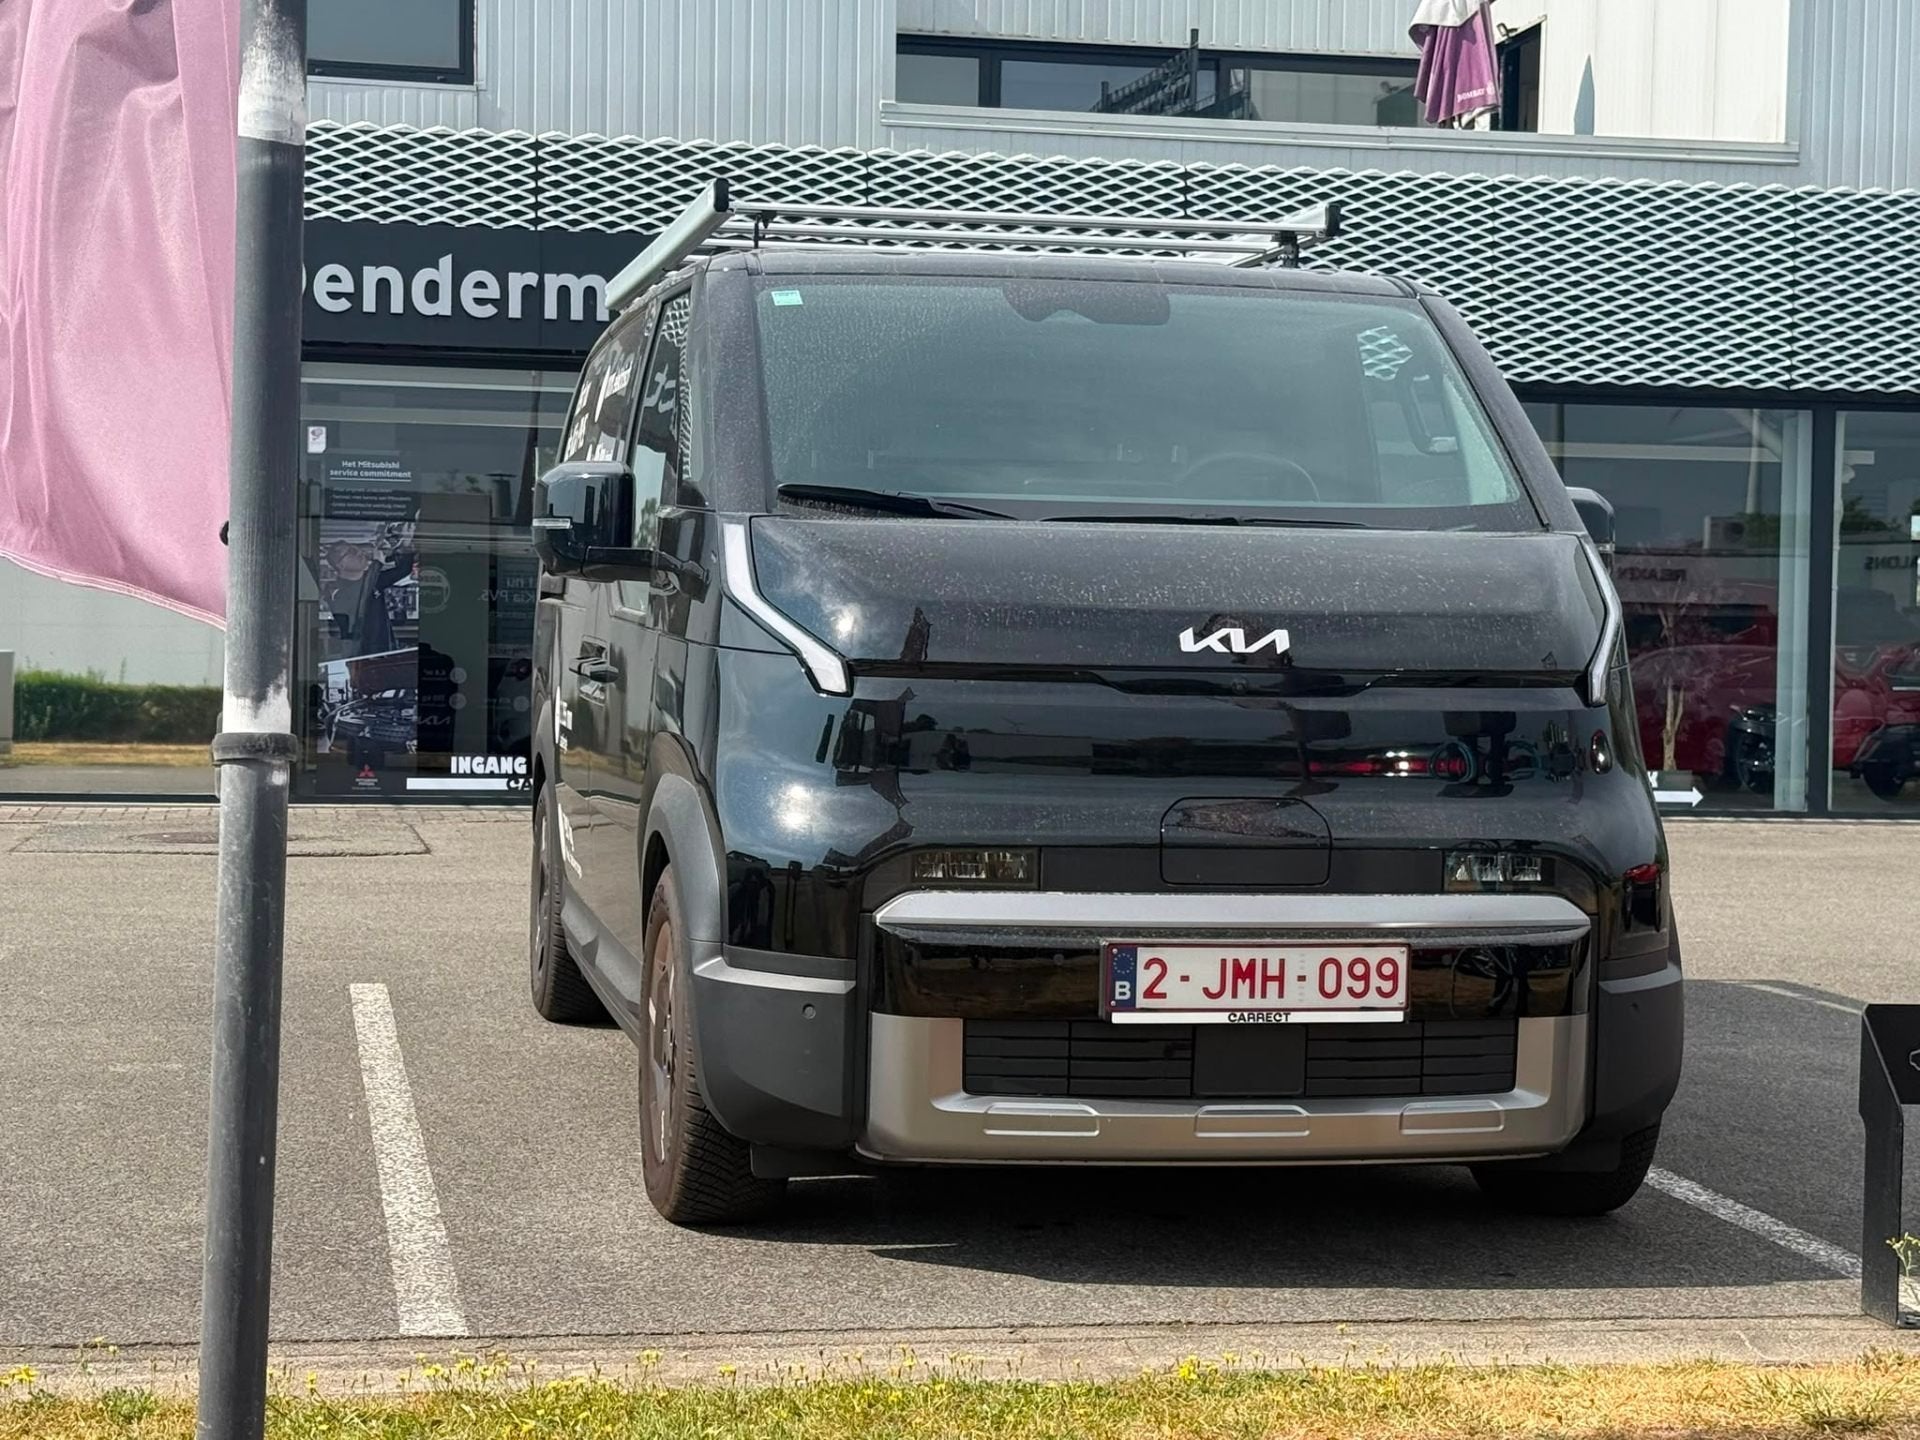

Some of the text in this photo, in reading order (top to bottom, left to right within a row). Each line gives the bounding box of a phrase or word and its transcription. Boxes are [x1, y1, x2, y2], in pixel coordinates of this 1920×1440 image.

[300, 253, 610, 322] enderm
[330, 469, 412, 479] service commitment
[342, 460, 400, 470] Het Mitsubishi
[1179, 627, 1290, 654] KIA
[450, 756, 527, 775] INGANG
[1114, 981, 1132, 1000] B
[1227, 1012, 1291, 1023] CARRECT
